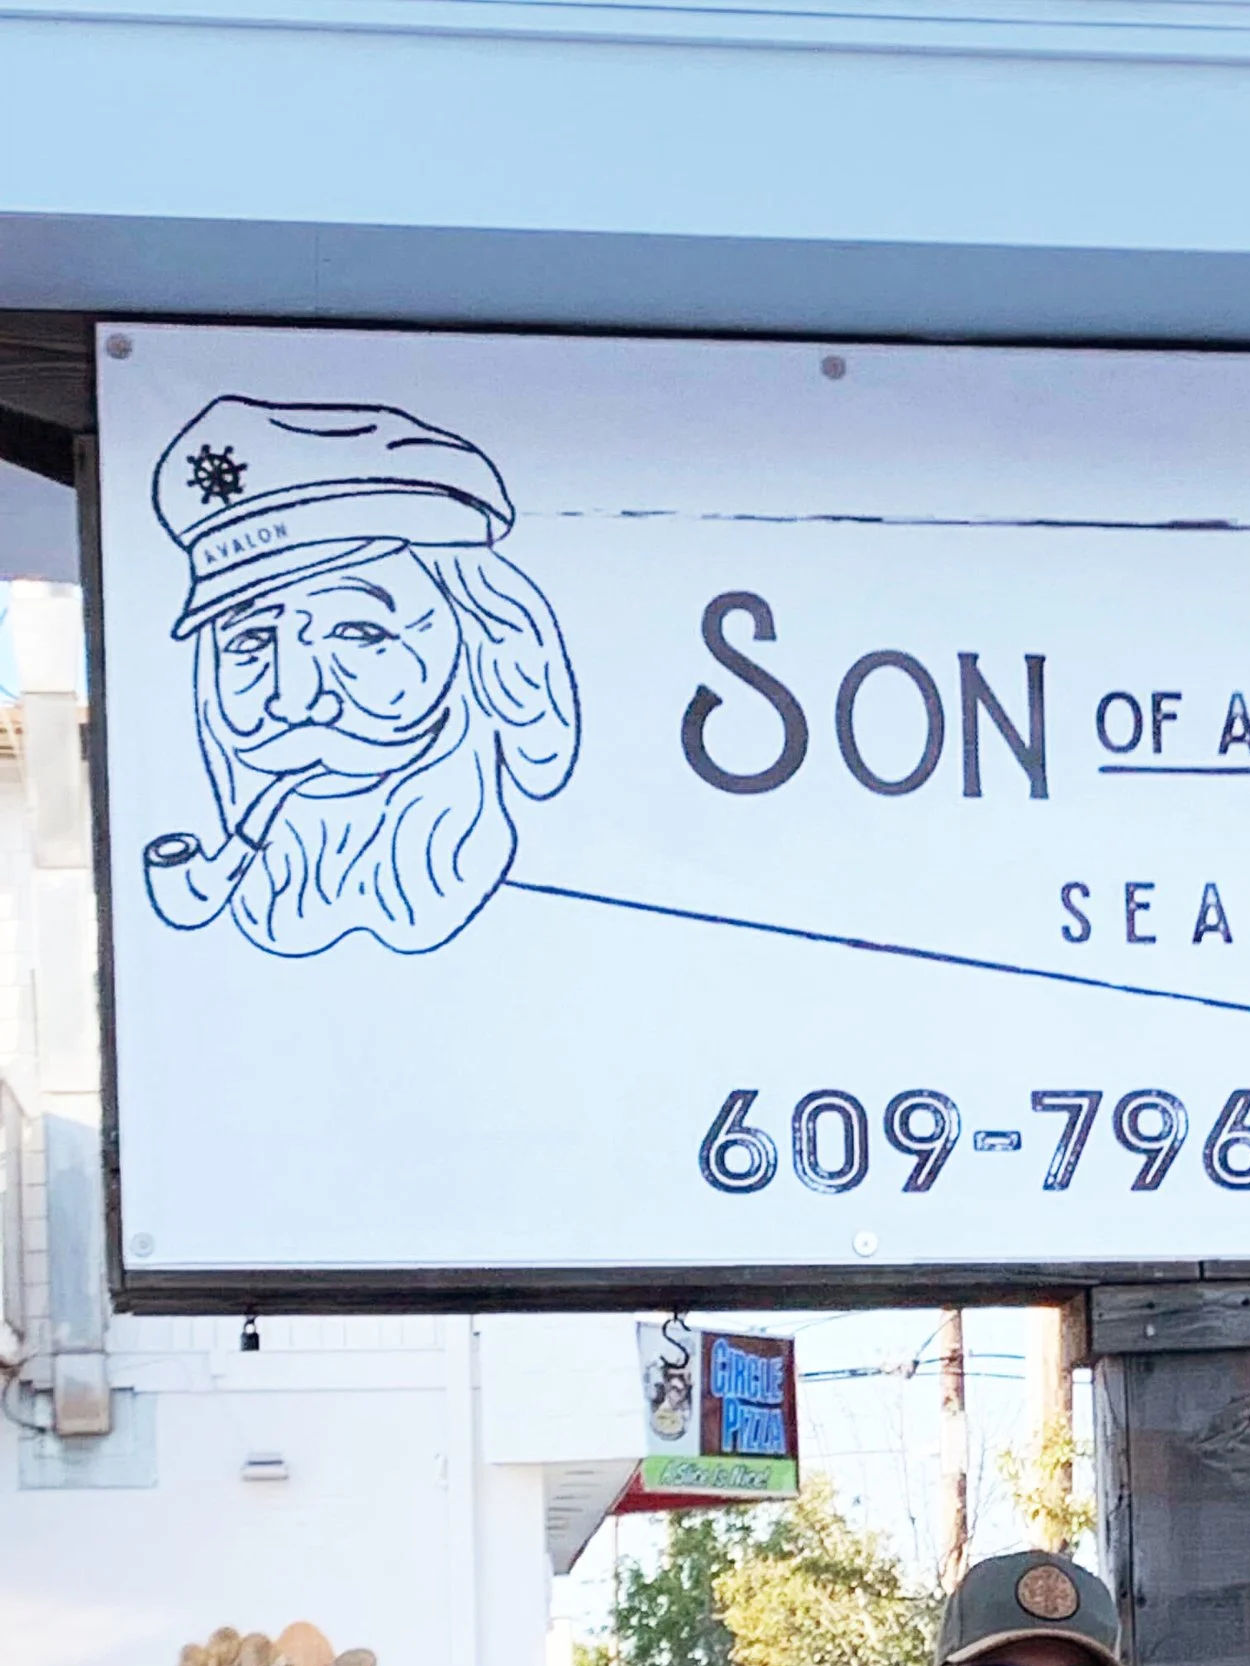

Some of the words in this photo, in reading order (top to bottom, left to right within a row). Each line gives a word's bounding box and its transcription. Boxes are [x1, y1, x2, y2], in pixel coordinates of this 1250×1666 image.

[205, 523, 287, 564] AVALON
[681, 591, 1049, 799] SON
[1096, 691, 1182, 755] OF
[711, 1337, 784, 1404] CIRCLE
[722, 1396, 786, 1454] PIZZA
